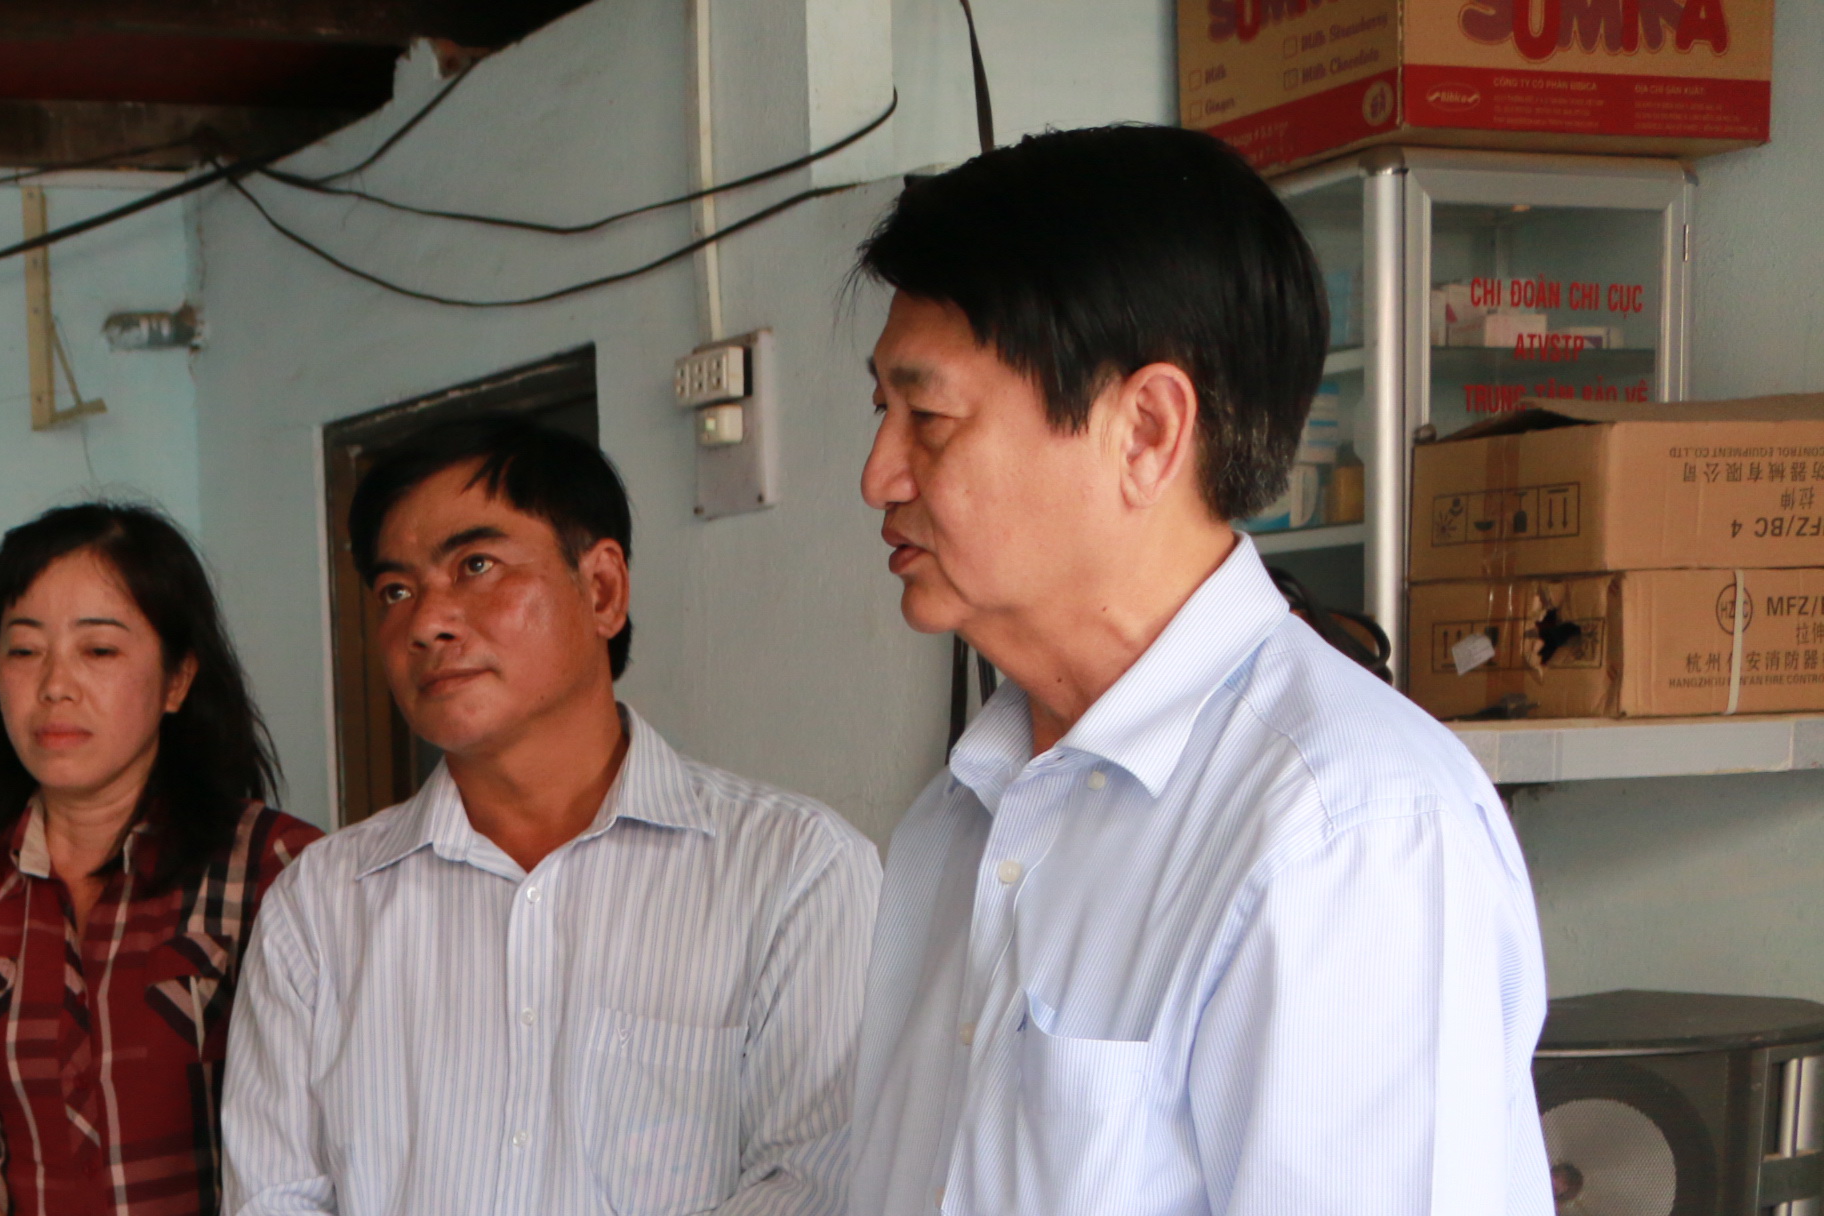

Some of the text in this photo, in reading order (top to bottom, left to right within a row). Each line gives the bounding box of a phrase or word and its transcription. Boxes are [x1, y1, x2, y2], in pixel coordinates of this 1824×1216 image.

[1470, 277, 1502, 307] CHI
[1569, 282, 1600, 311] CHI
[1608, 283, 1644, 319] CỤC
[1513, 333, 1585, 362] ATVSTP
[1754, 515, 1824, 538] FZ/BC
